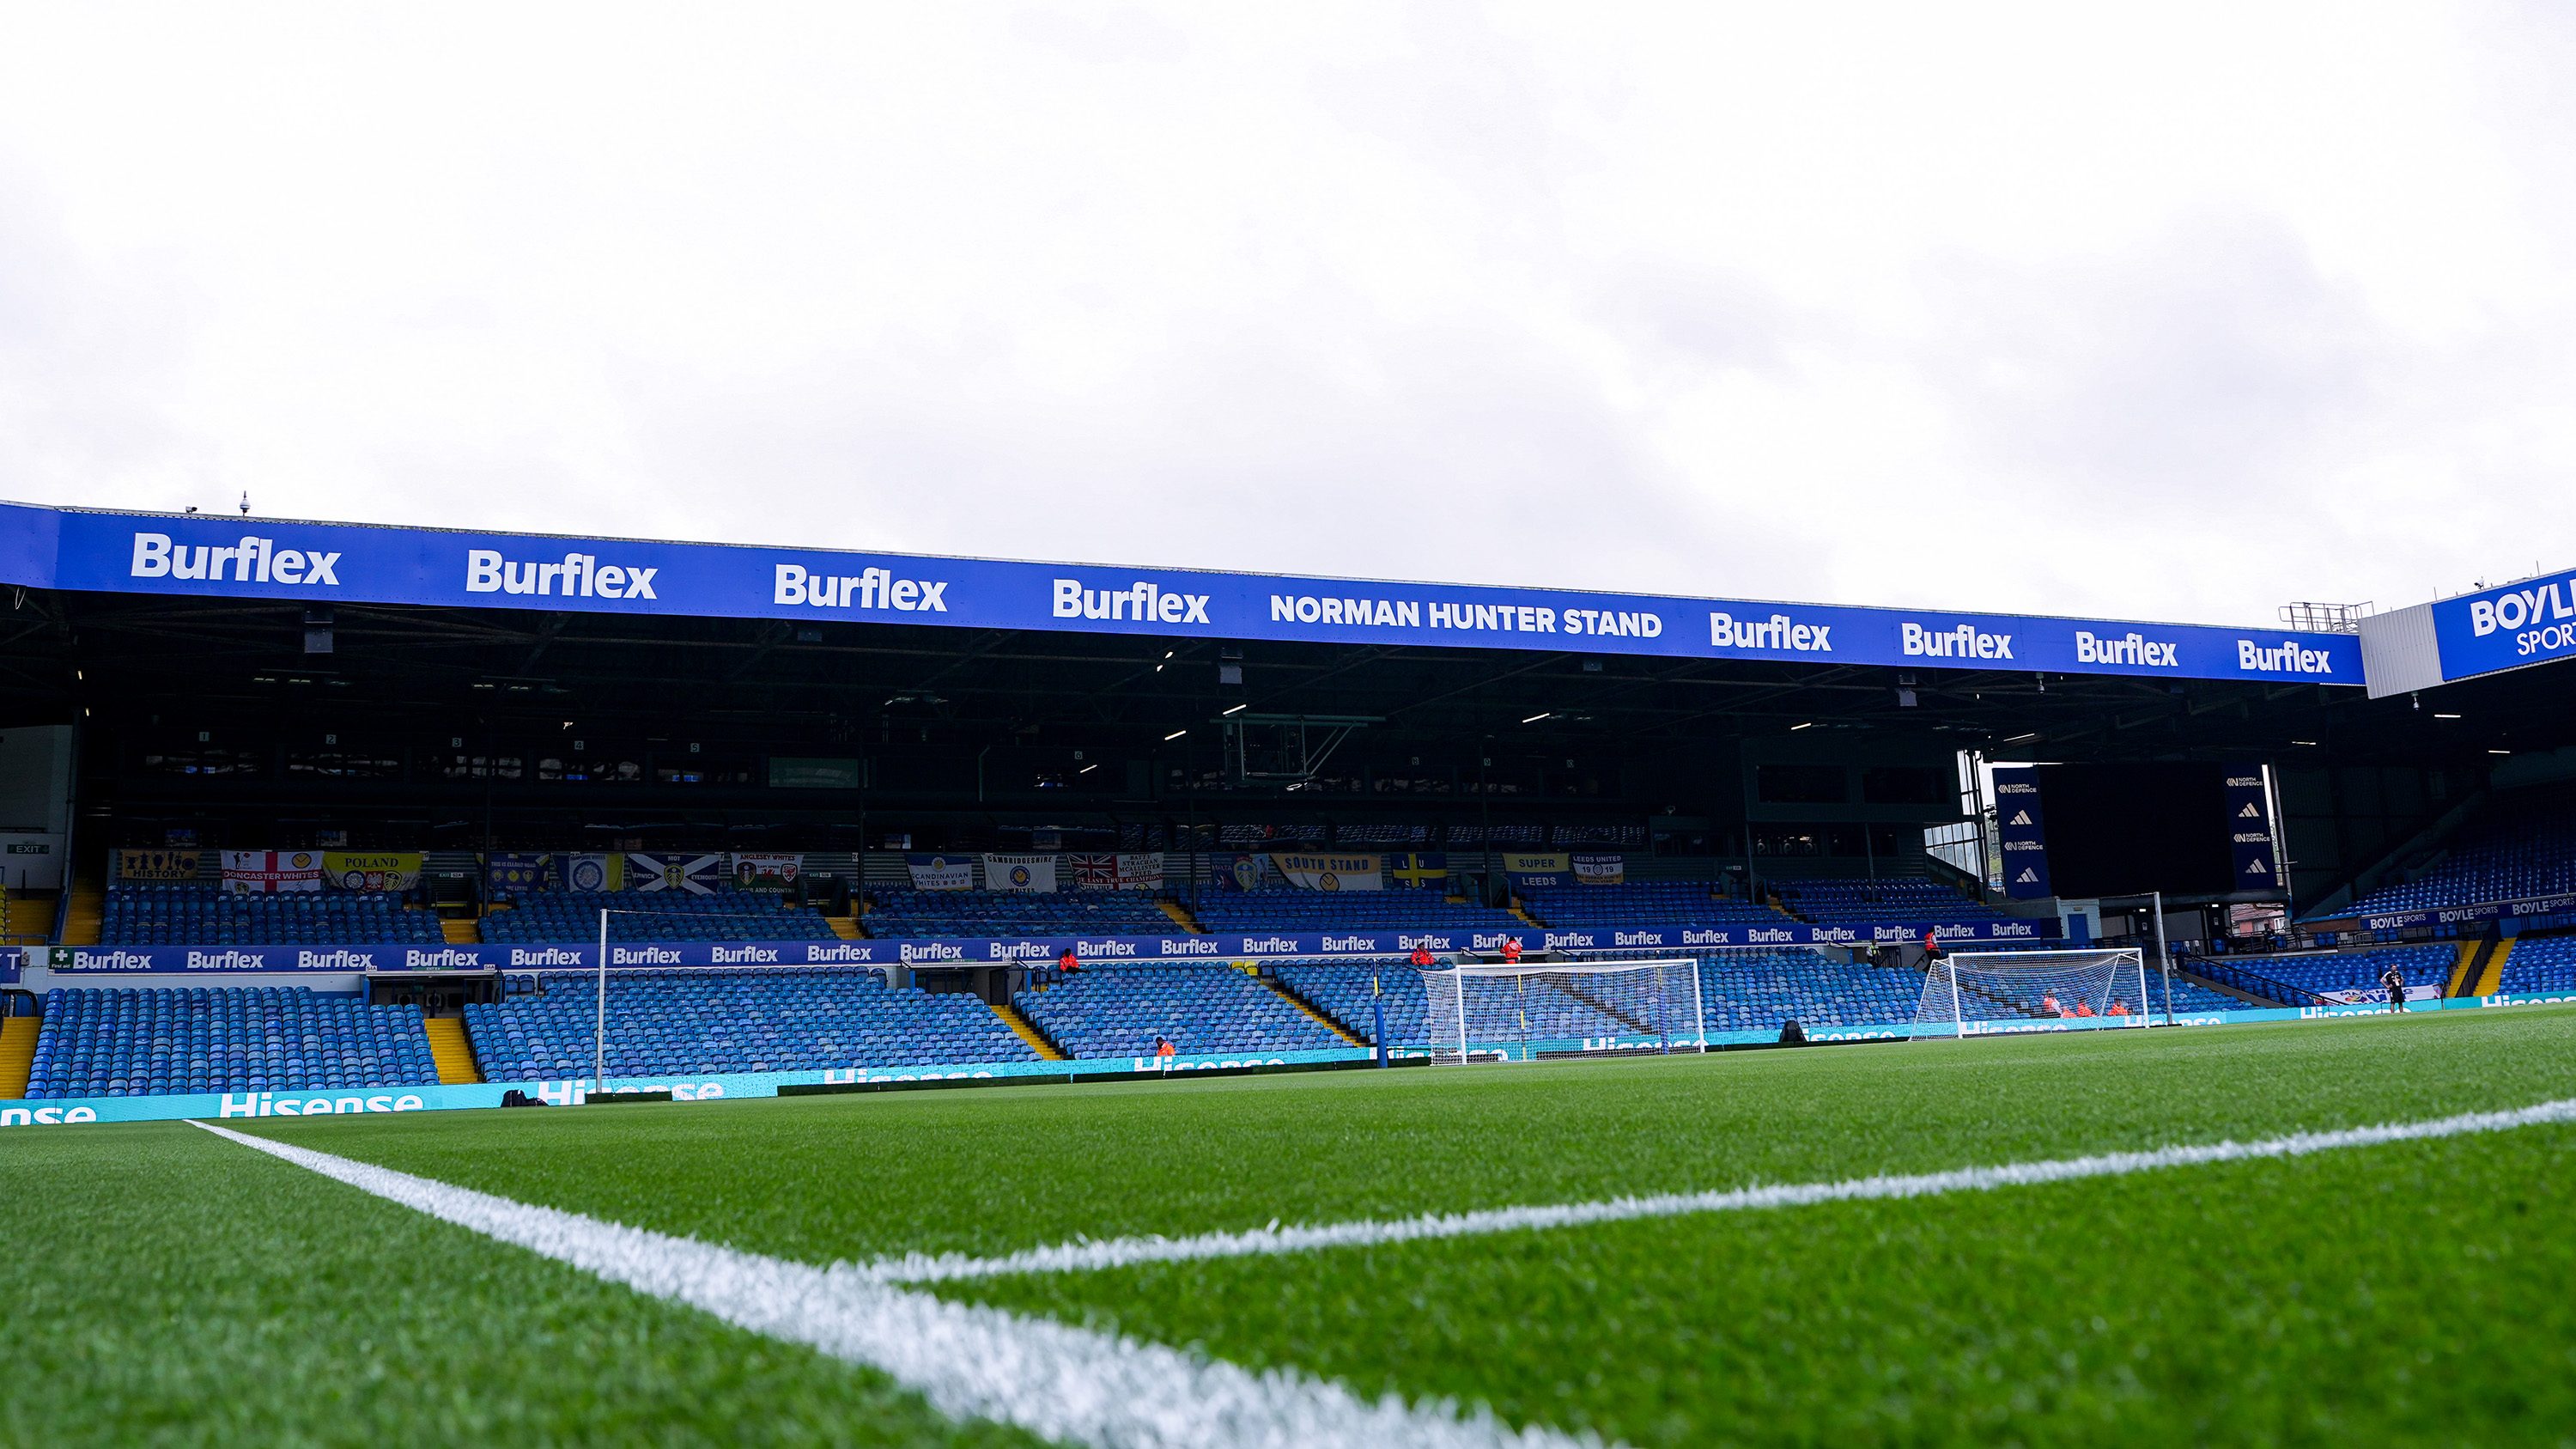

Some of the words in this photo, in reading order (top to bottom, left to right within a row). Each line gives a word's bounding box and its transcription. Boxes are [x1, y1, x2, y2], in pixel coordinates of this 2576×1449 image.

[131, 533, 342, 586] Burflex
[465, 549, 659, 600] Burflex
[774, 563, 949, 612] Burflex
[1053, 578, 1211, 624] Burflex
[2470, 579, 2576, 637] BOYL
[1270, 594, 1420, 627] NORMAN
[1428, 602, 1557, 633] HUNTER
[1563, 608, 1663, 638] STAND
[1710, 612, 1832, 652] Burflex
[2517, 623, 2576, 656] SPOR
[1901, 623, 2014, 660] Burflex
[2075, 630, 2179, 667] Burflex
[2237, 639, 2332, 673] Burflex
[15, 845, 41, 854] EXIT
[345, 858, 399, 868] POLAND
[1285, 856, 1325, 870] SOUTH
[1330, 859, 1369, 871] STAND
[1401, 860, 1407, 868] L
[1419, 859, 1425, 868] U
[1518, 859, 1555, 868] SUPER
[133, 869, 186, 878] HISTORY
[223, 870, 282, 880] DONCASTER
[282, 871, 319, 880] WHITES
[1522, 876, 1558, 886] LEEDS
[1420, 879, 1426, 887] S
[1682, 928, 1729, 944] Burflex
[1748, 928, 1794, 942] Burflex
[1812, 927, 1856, 941] Burflex
[1874, 925, 1917, 940] Burflex
[1934, 924, 1975, 938] Burflex
[1992, 922, 2032, 936] Burflex
[1161, 938, 1218, 955] Burflex
[1242, 936, 1298, 953] Burflex
[1321, 935, 1376, 952] Burflex
[1473, 933, 1523, 949] Burflx
[1545, 932, 1594, 947] Burflex
[1614, 930, 1662, 946] Burflex
[511, 947, 582, 966] Burflex
[612, 947, 682, 965] Burflex
[711, 946, 779, 963] Burflex
[807, 944, 872, 962] Burflex
[900, 942, 963, 959] Burflex
[989, 941, 1050, 959] Burflex
[1077, 940, 1136, 957] Burflex
[73, 951, 152, 970] Burflex
[186, 950, 264, 969] Burflex
[298, 950, 373, 968] Burflex
[405, 949, 479, 967] Burflex
[538, 1081, 724, 1106] Hise
[221, 1093, 423, 1117] Hisense
